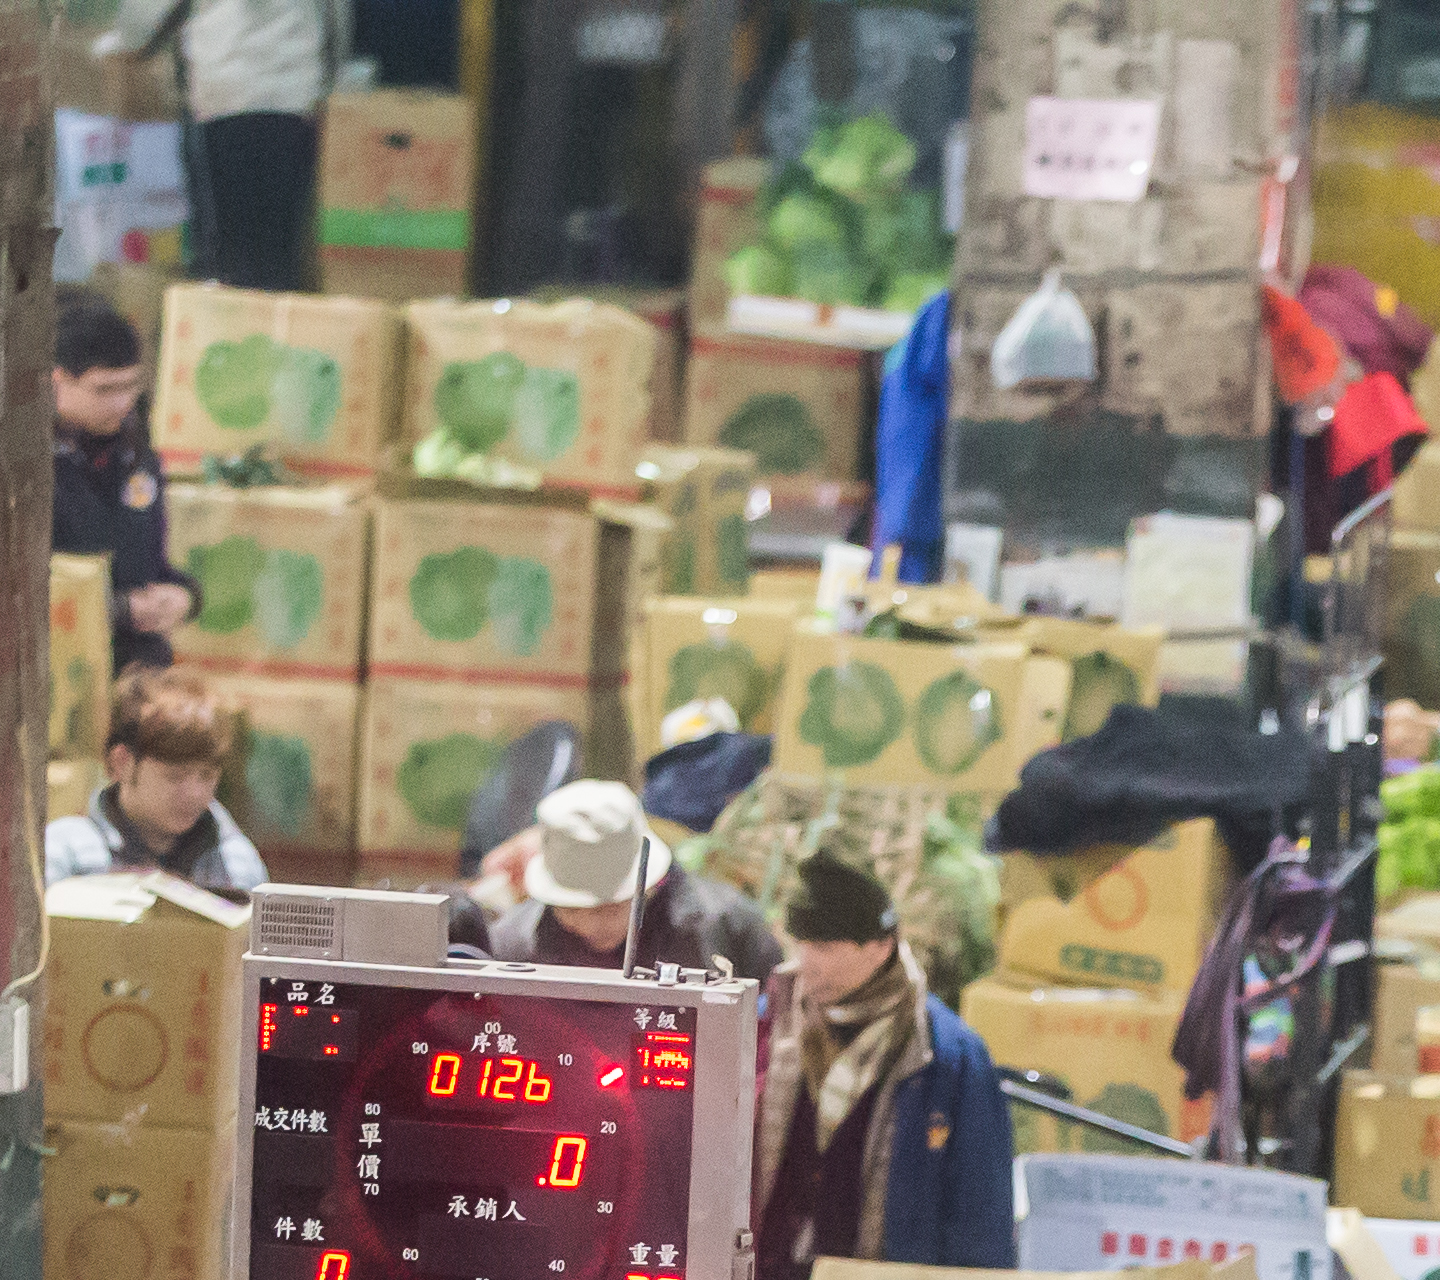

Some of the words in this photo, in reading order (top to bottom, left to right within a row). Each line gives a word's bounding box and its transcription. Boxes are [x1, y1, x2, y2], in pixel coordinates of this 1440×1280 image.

[287, 983, 337, 1005] 品名
[634, 1008, 679, 1031] 等級
[485, 1022, 501, 1035] 00
[412, 1042, 429, 1055] 90
[471, 1034, 518, 1054] 序號
[558, 1054, 573, 1066] 10
[364, 1103, 381, 1116] 80
[254, 1108, 328, 1133] 成交件數
[600, 1121, 617, 1135] 20
[357, 1122, 382, 1180] 單價
[363, 1182, 380, 1196] 70
[447, 1195, 526, 1221] 承銷人
[597, 1202, 613, 1214] 30
[274, 1216, 325, 1241] 件數
[402, 1248, 419, 1261] 60
[628, 1243, 679, 1267] 重量
[548, 1259, 565, 1273] 40
